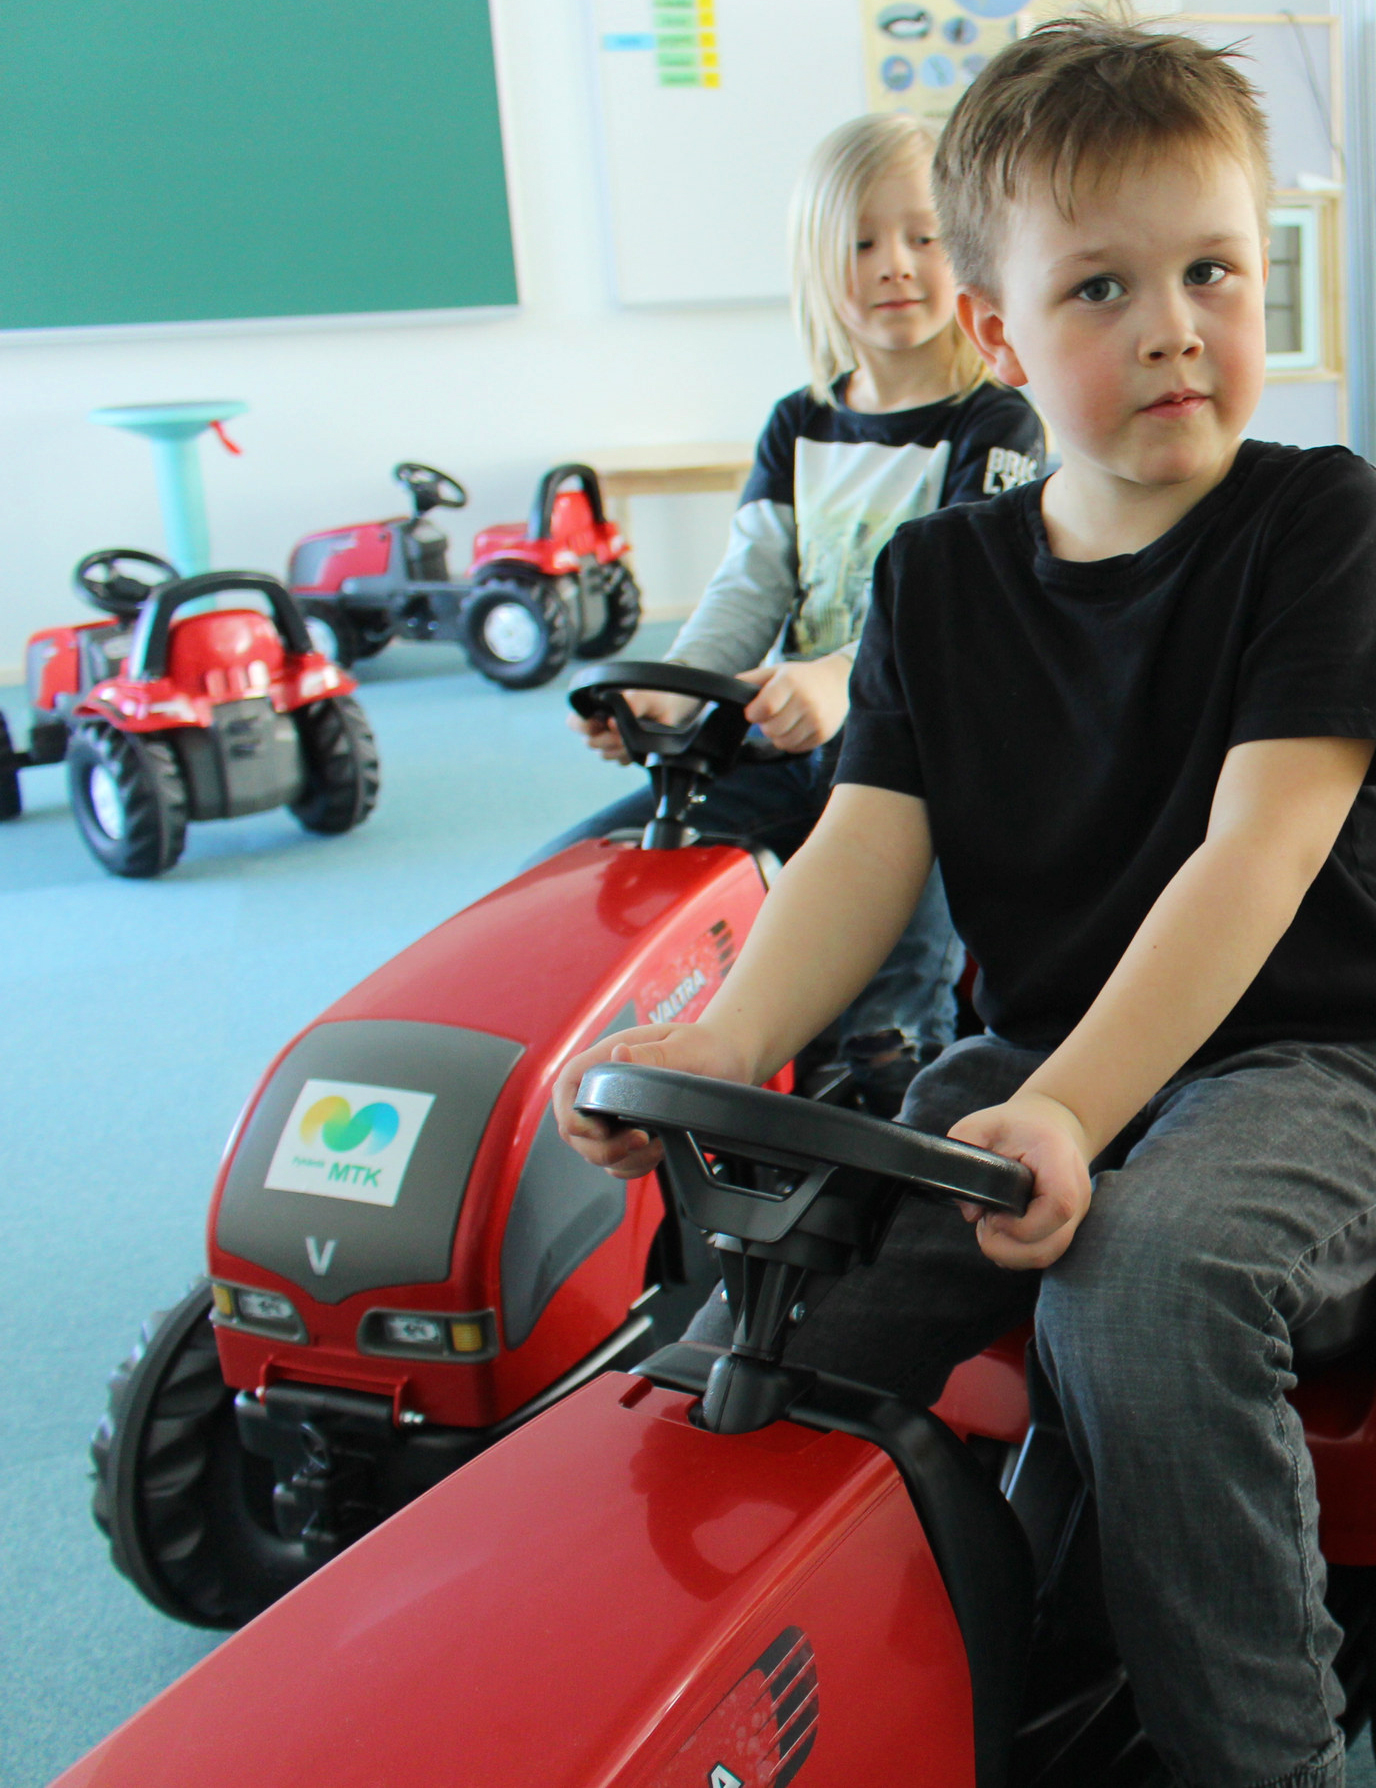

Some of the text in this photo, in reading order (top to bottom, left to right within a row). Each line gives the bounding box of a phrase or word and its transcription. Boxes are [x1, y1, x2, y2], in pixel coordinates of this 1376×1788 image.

[648, 968, 706, 1024] VALTRA
[328, 1162, 382, 1187] MTK
[305, 1236, 337, 1276] V
